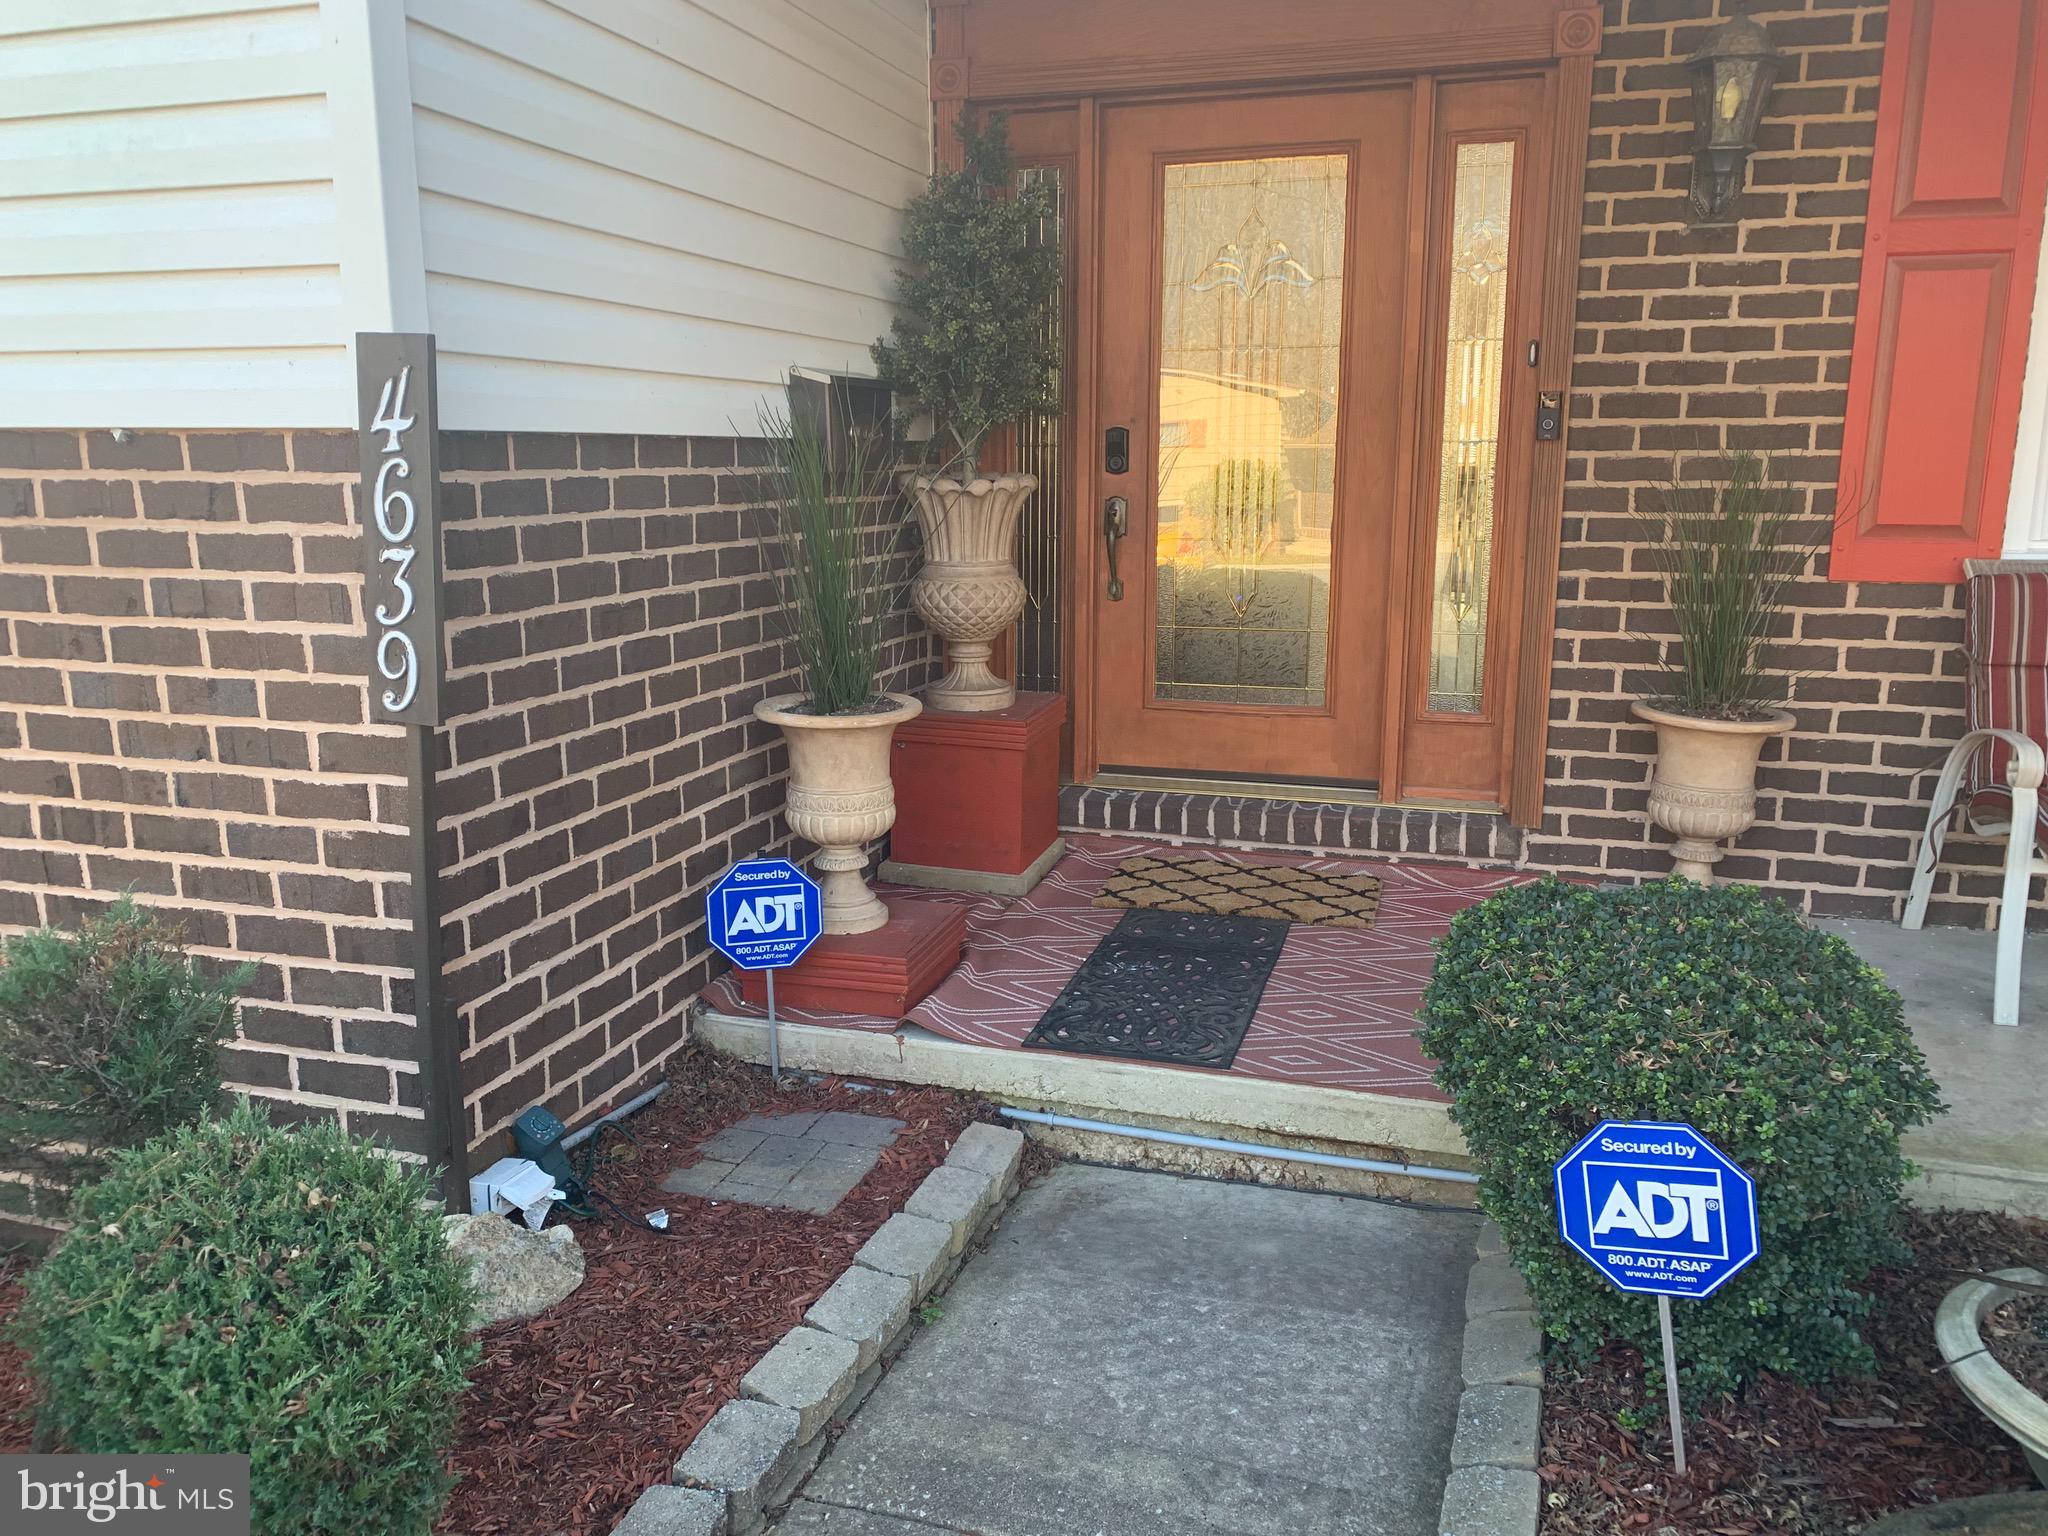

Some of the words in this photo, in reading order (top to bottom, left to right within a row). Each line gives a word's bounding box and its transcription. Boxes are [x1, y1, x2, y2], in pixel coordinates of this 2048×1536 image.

[369, 364, 419, 713] 4639
[734, 870, 777, 882] Secured
[778, 869, 791, 880] by
[735, 942, 797, 955] 800.ADT.ASAP
[745, 952, 789, 961] www.ADT.com
[1601, 1137, 1673, 1156] Secured
[1675, 1142, 1697, 1160] by
[1607, 1253, 1712, 1274] 800.ADT.ASAP
[1625, 1269, 1698, 1284] www.ADT.com
